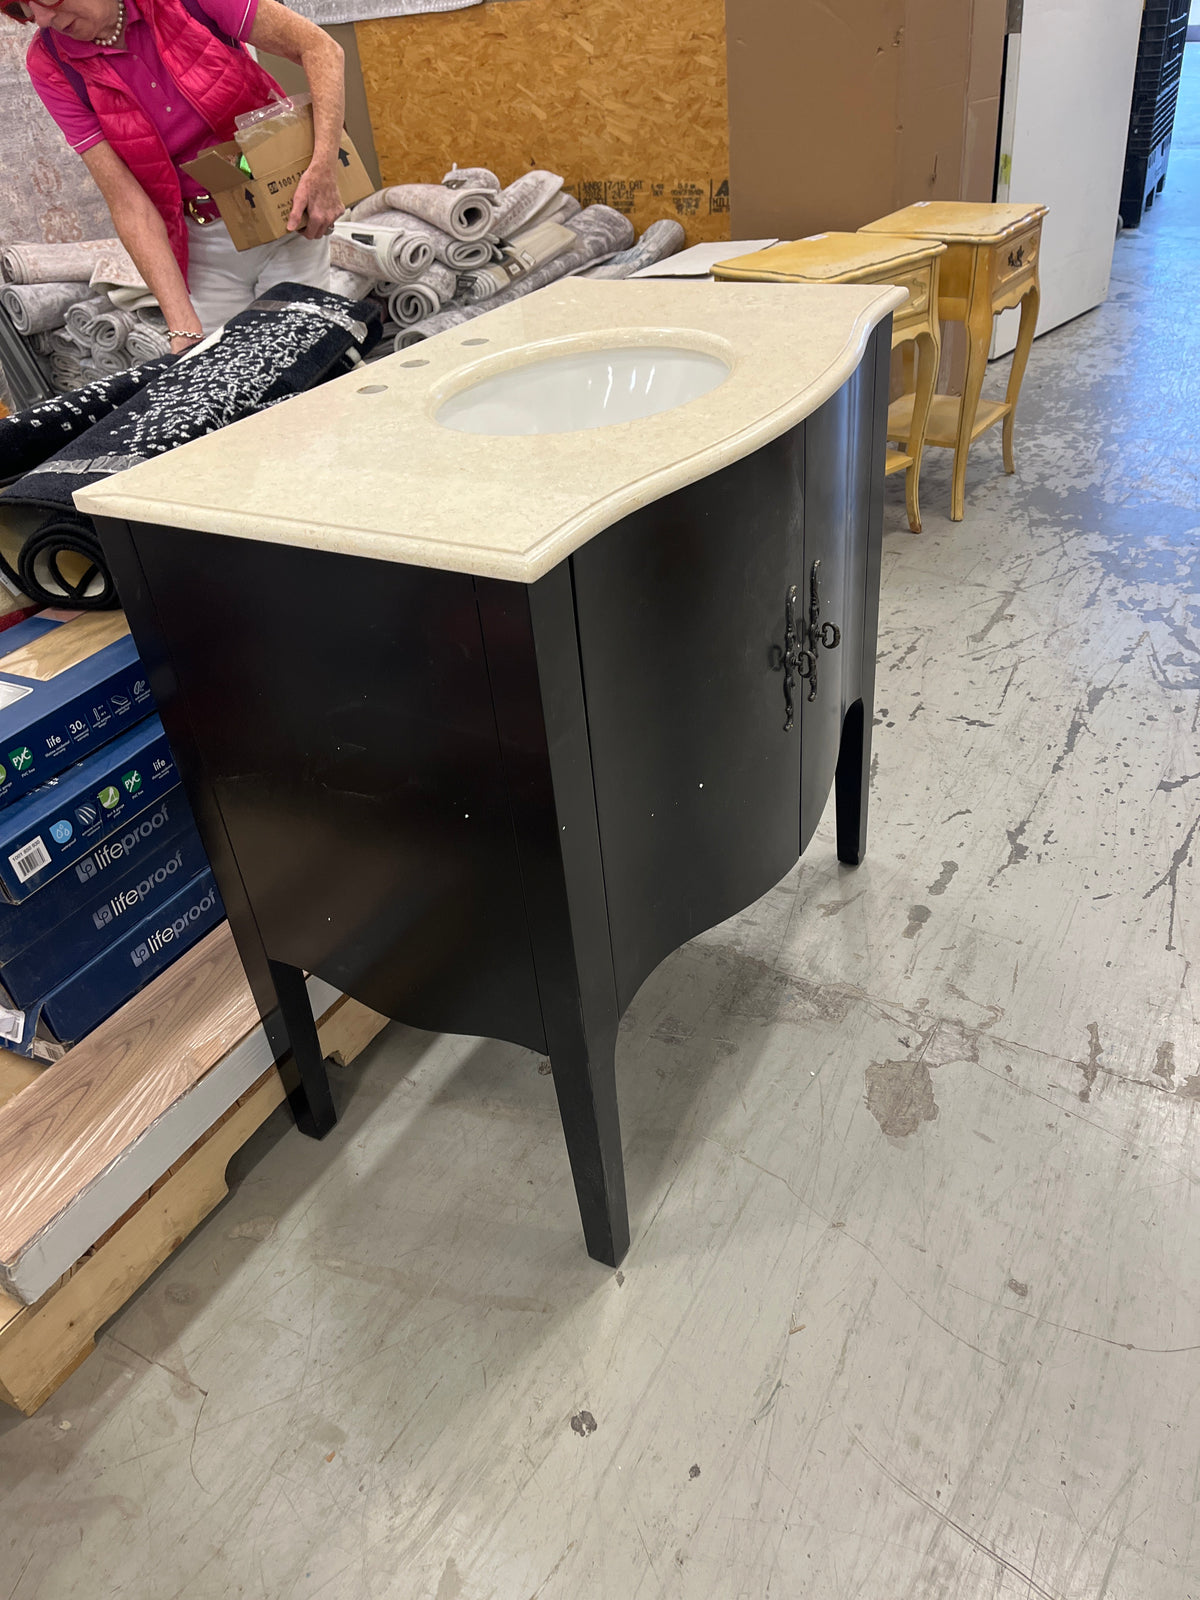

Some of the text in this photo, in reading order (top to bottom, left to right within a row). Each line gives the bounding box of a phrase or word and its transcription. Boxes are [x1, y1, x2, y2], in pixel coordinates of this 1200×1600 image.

[278, 175, 297, 188] 1001
[69, 720, 83, 734] 30
[46, 735, 61, 748] life
[153, 759, 166, 772] life
[94, 803, 169, 870] lifeproof
[110, 850, 183, 917] lifeproof
[147, 887, 216, 954] lifeproof
